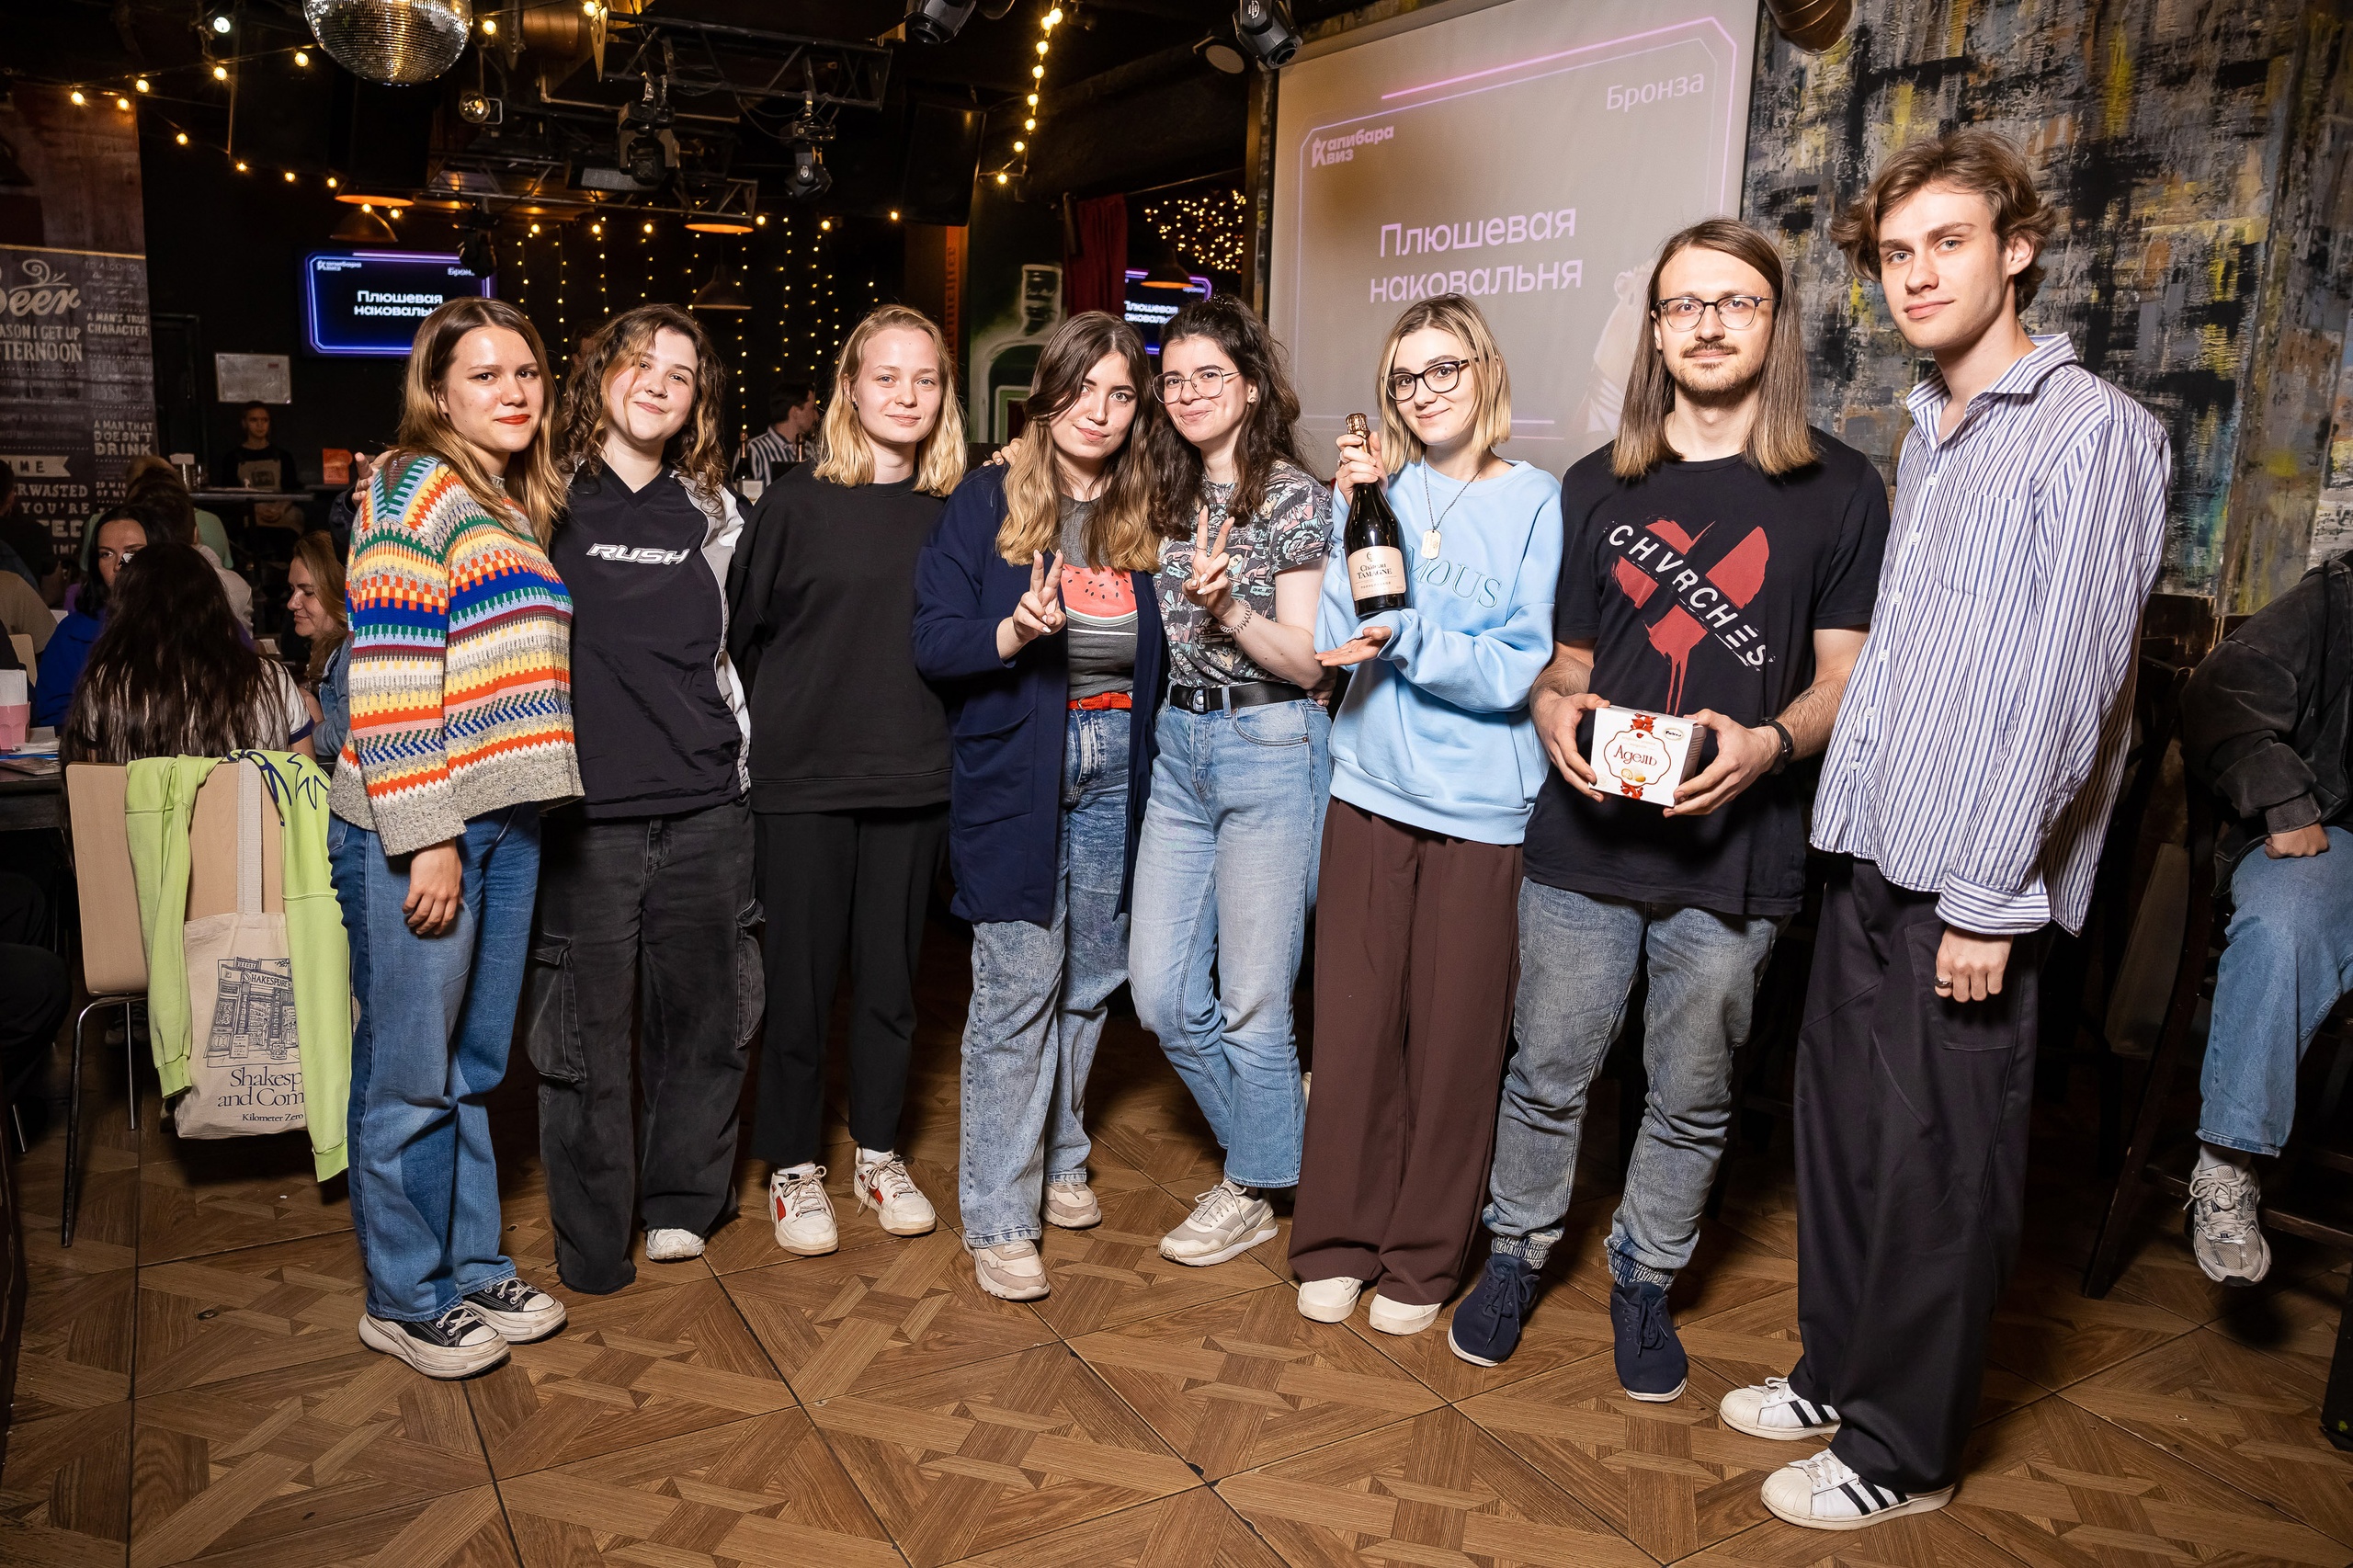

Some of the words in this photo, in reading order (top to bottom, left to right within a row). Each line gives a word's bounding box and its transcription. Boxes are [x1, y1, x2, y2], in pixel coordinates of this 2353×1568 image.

[1606, 73, 1705, 112] Бронза
[1380, 208, 1576, 257] Плюшевая
[448, 267, 475, 276] Брон
[1370, 259, 1583, 303] наковальня
[0, 288, 81, 317] eer
[357, 290, 443, 304] Плюшевая
[354, 305, 438, 317] наковаль
[0, 324, 31, 338] ASON
[65, 326, 81, 340] UP
[87, 323, 147, 336] CHARACTER
[0, 340, 83, 362] TERNOON
[103, 419, 125, 430] MAN
[127, 422, 153, 432] THAT
[94, 430, 153, 443] DOESN'T
[95, 442, 152, 456] DRINK
[21, 502, 90, 514] YOU'RE
[585, 542, 690, 565] RUSH
[230, 1066, 302, 1092] Shakesp
[217, 1086, 253, 1108] and
[256, 1087, 304, 1107] Com
[242, 1112, 283, 1122] Kilometer
[284, 1113, 304, 1122] Zero
